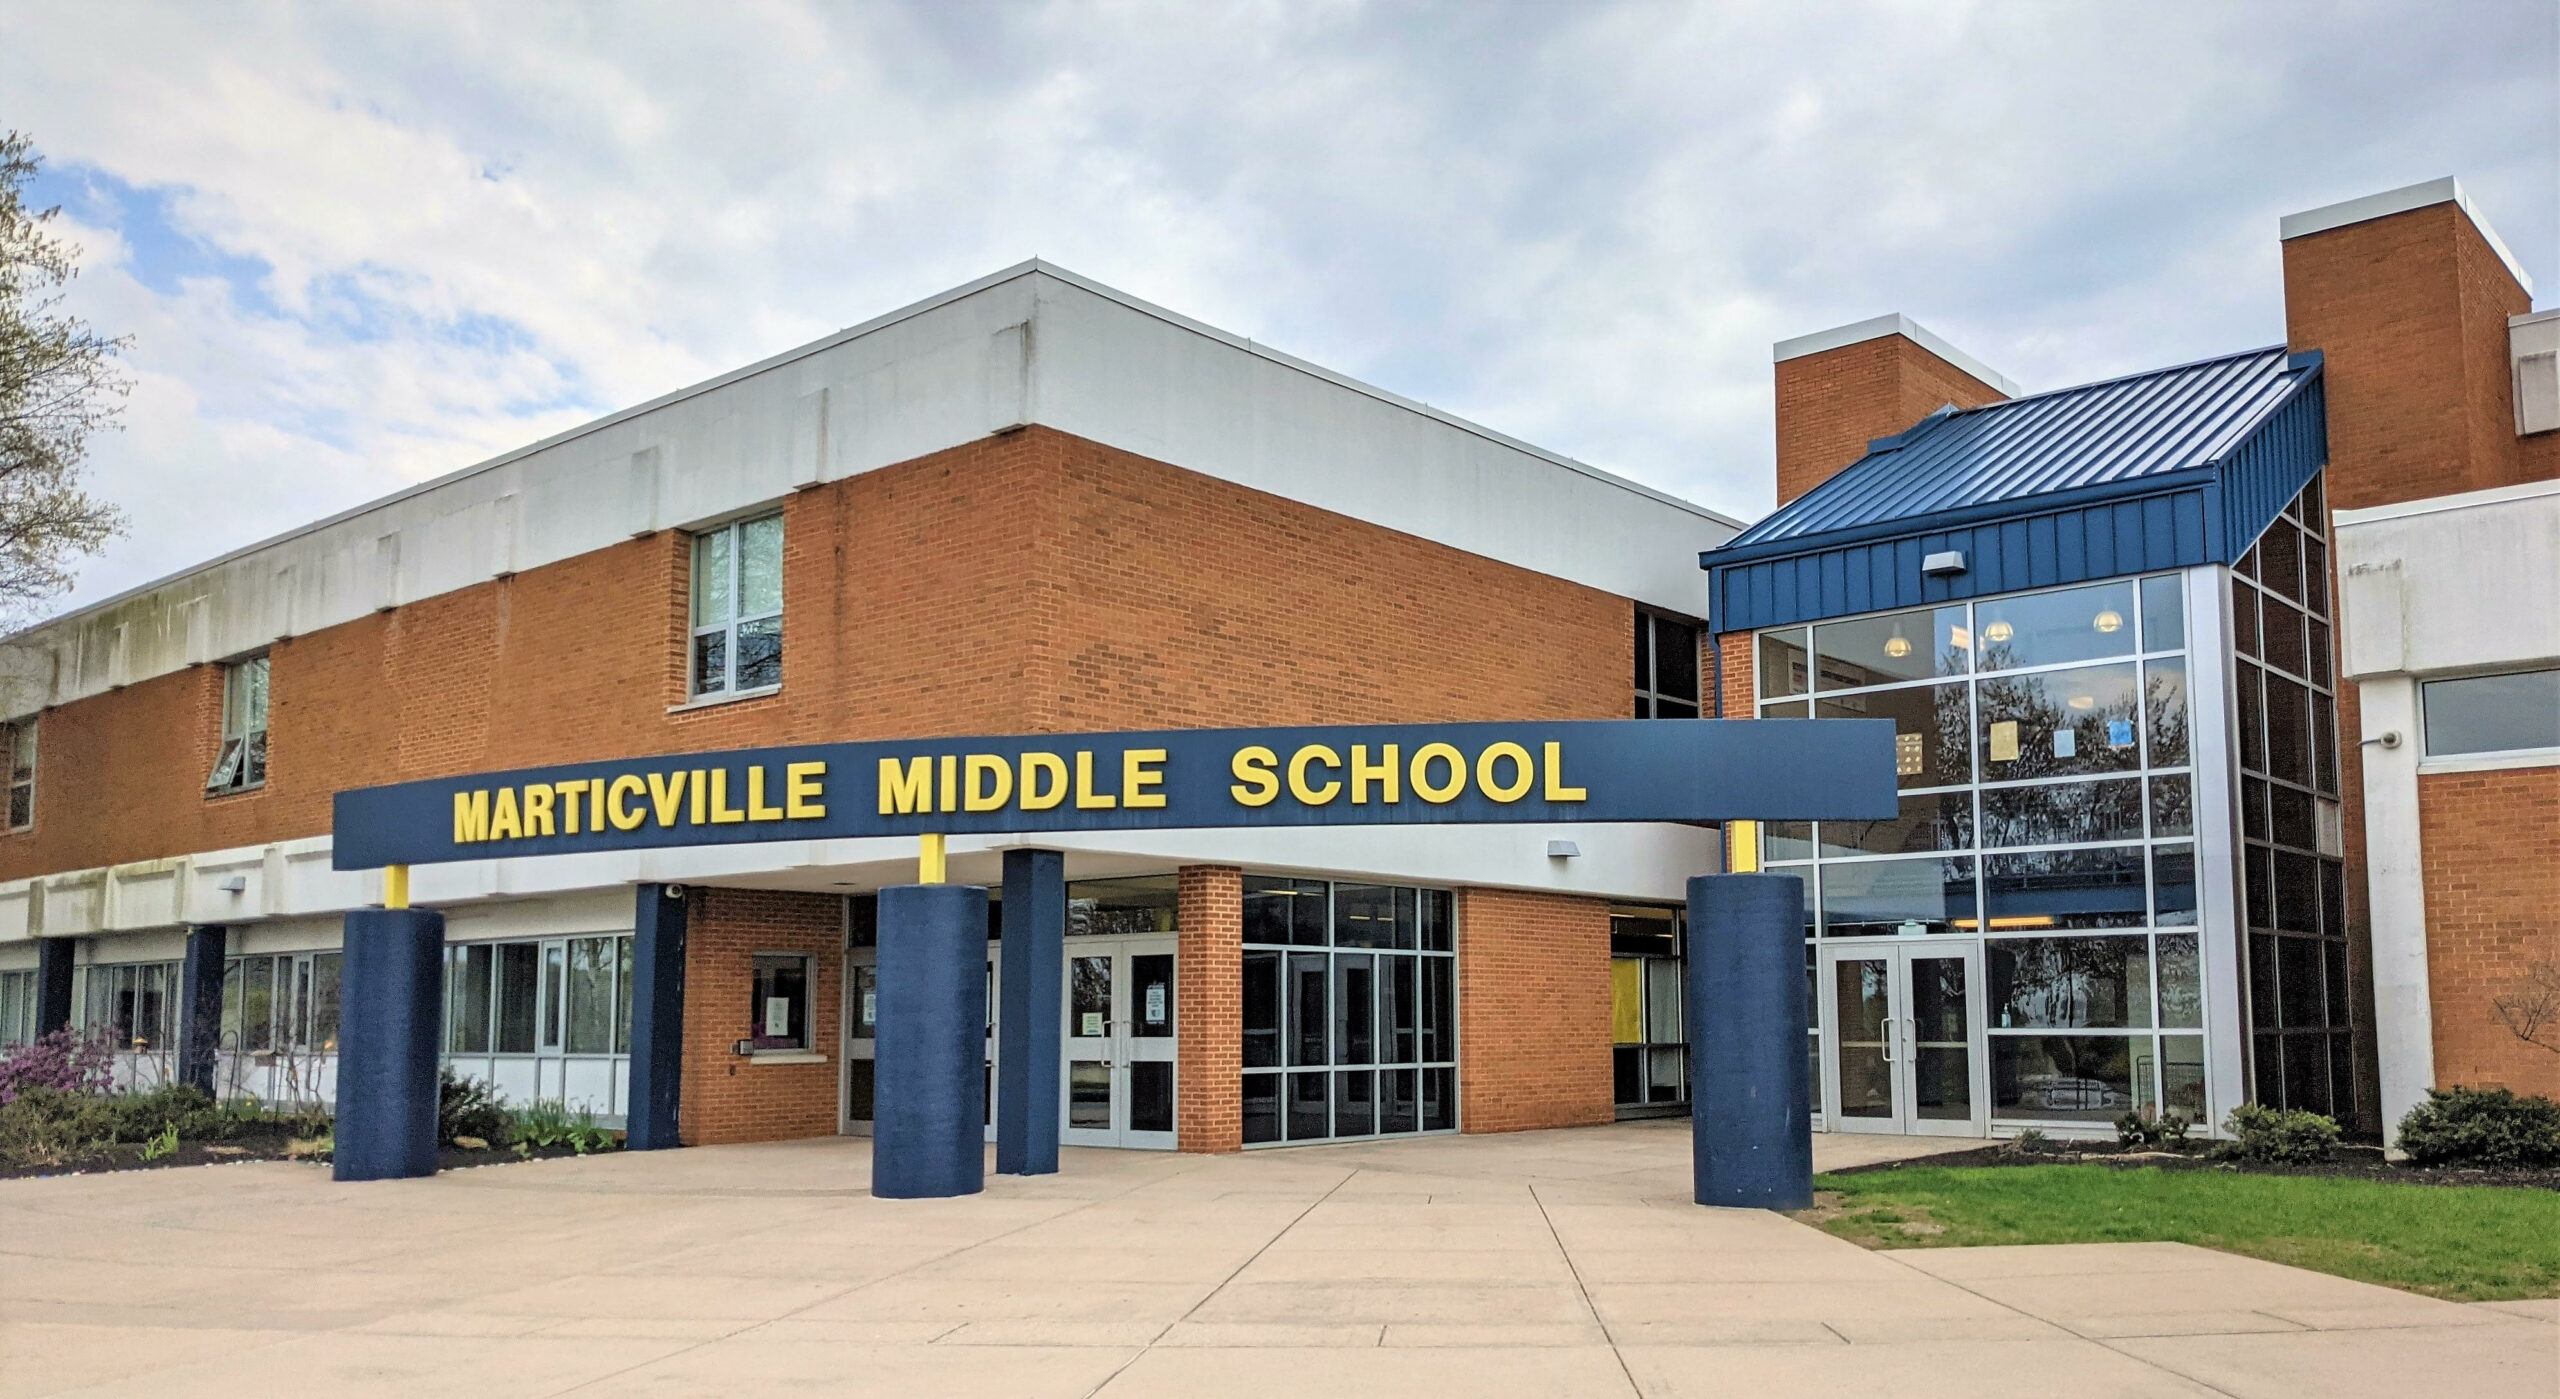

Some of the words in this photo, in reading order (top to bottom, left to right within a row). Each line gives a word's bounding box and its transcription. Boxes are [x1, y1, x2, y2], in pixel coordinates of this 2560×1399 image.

[453, 761, 827, 843] MARTICVILLE
[877, 748, 1168, 815] MIDDLE
[1230, 741, 1587, 807] SCHOOL
